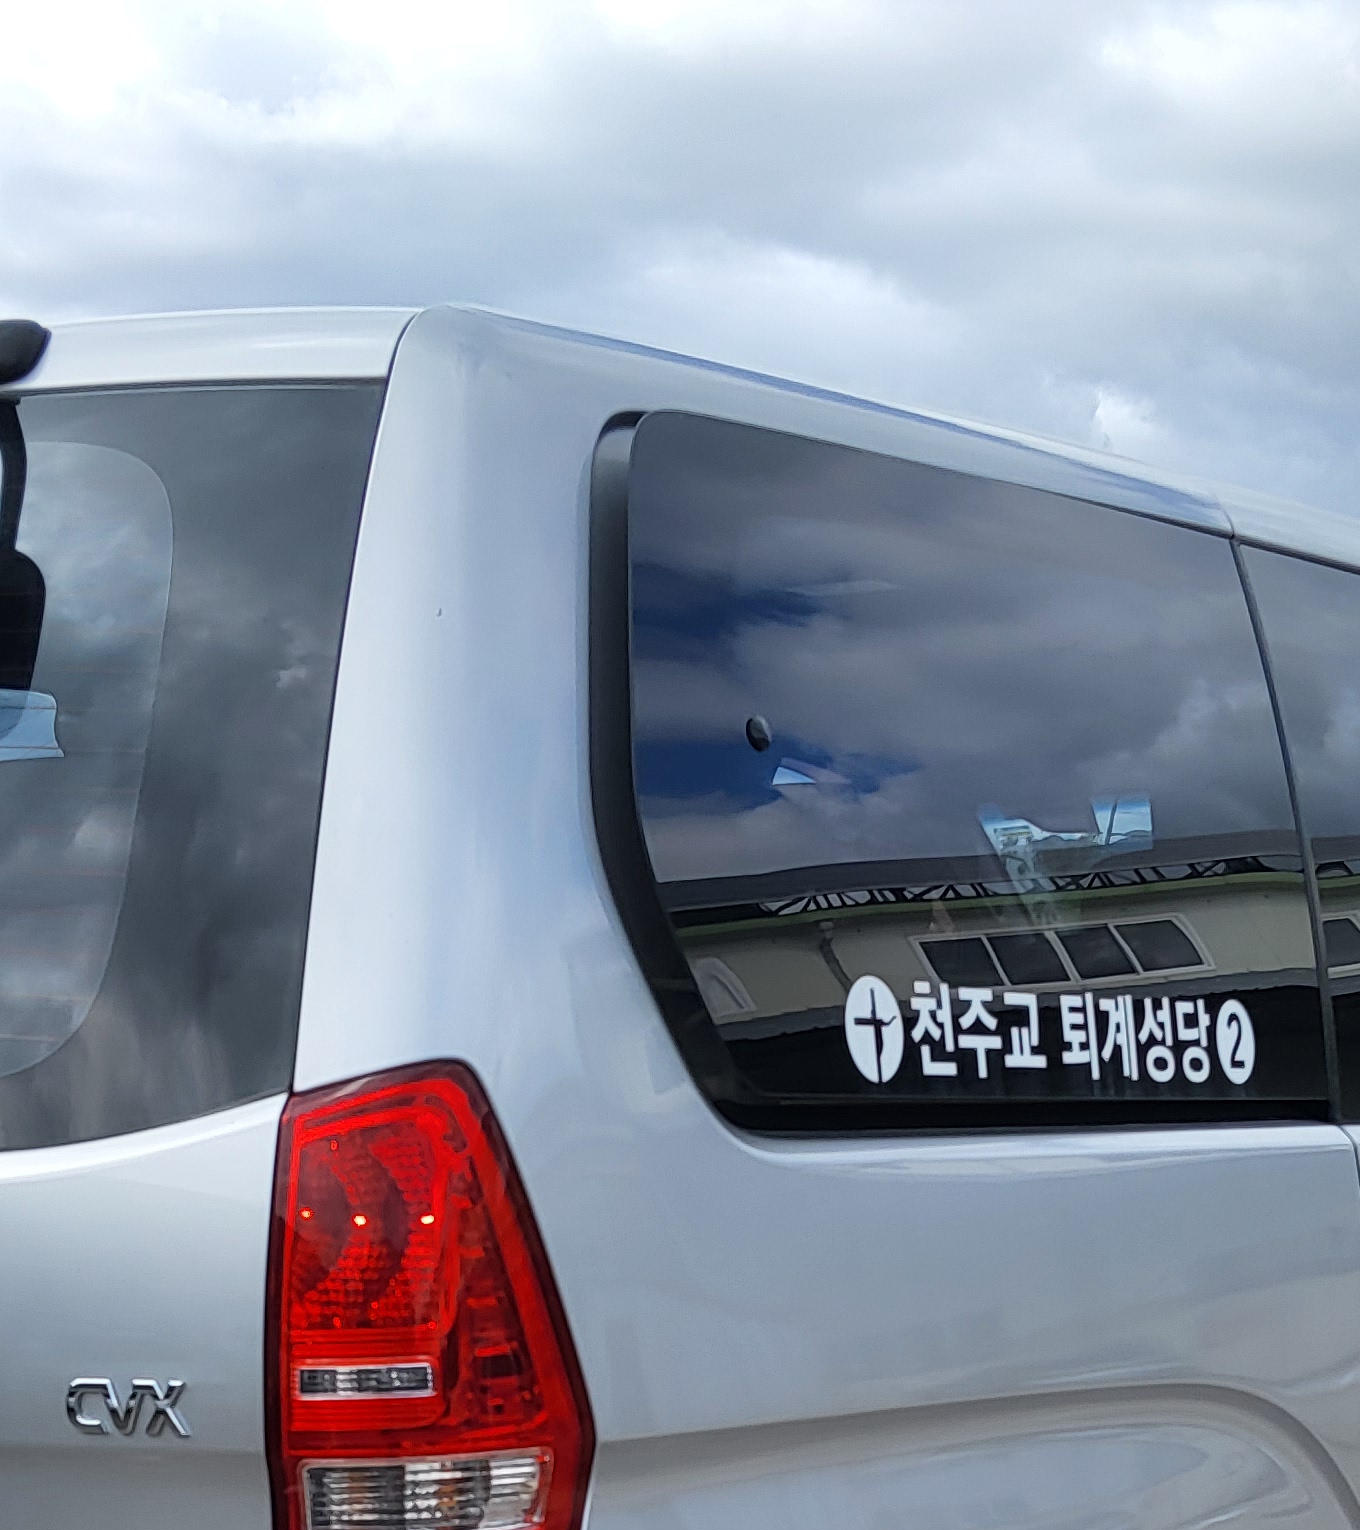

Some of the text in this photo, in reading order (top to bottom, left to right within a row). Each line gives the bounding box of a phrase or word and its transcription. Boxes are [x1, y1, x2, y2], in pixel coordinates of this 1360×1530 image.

[910, 981, 1048, 1079] 천주교
[1060, 991, 1211, 1083] 퇴계성당
[66, 1376, 191, 1437] CVX
